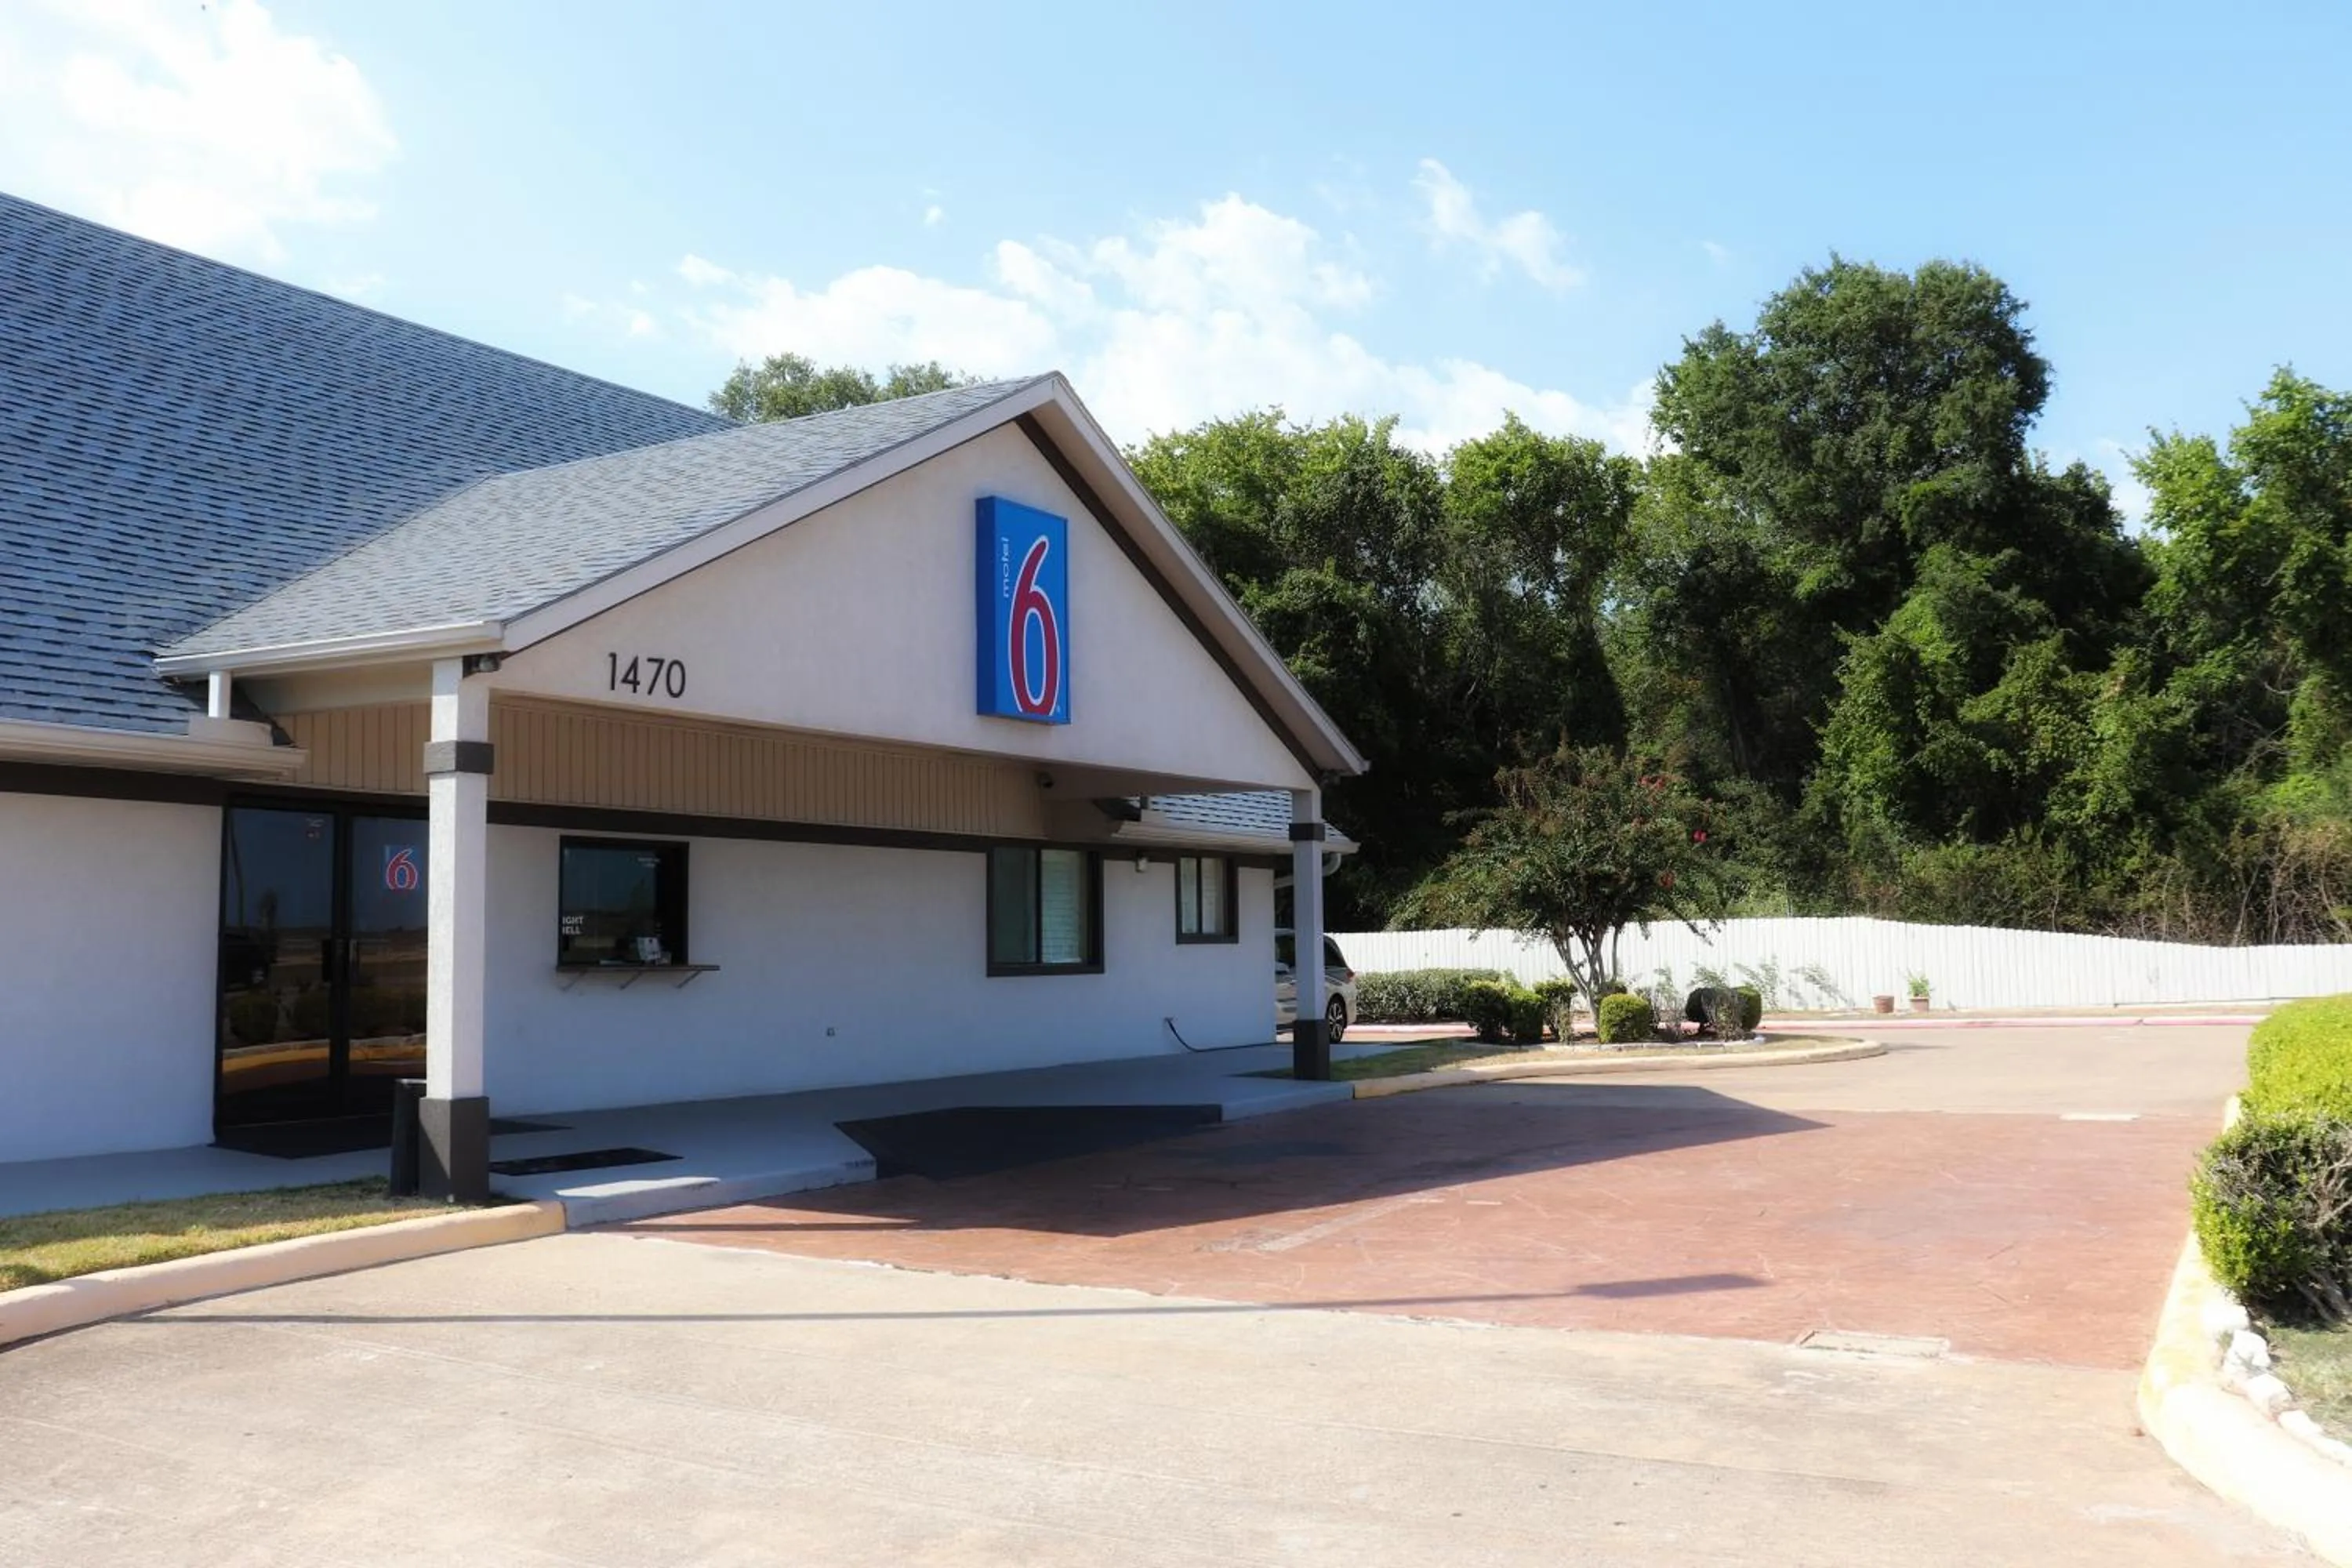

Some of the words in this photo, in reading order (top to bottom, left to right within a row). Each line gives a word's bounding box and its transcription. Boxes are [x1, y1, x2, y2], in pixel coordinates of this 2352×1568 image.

[1008, 535, 1061, 716] 6
[608, 652, 686, 699] 1470
[385, 848, 418, 890] 6
[562, 915, 583, 924] IGHT
